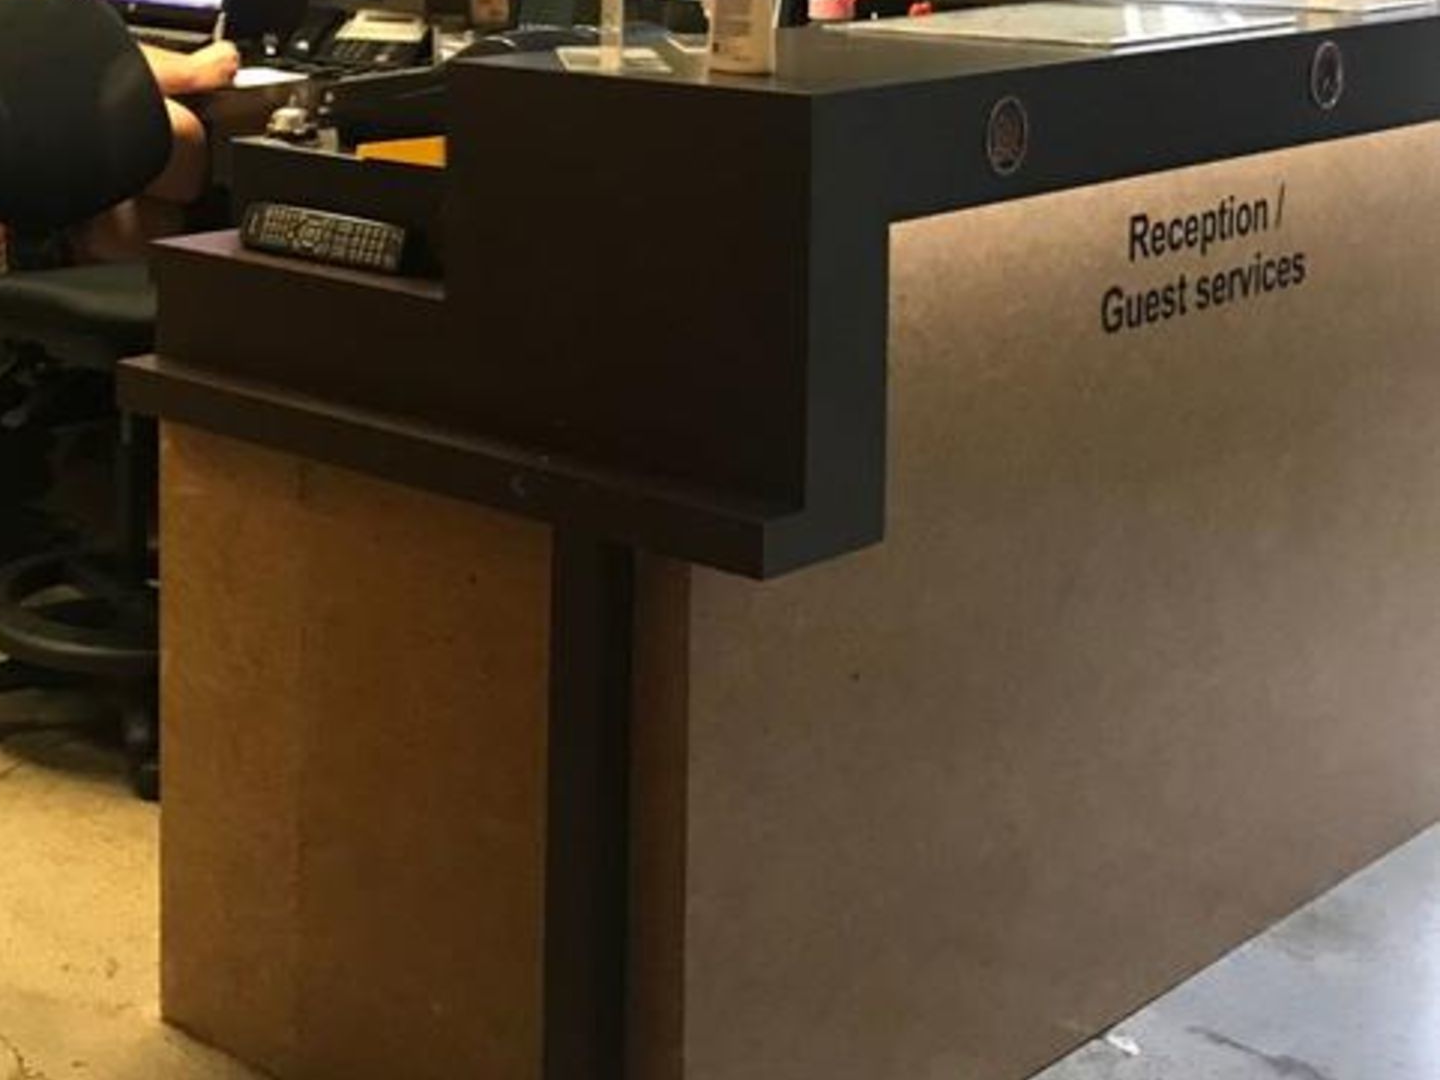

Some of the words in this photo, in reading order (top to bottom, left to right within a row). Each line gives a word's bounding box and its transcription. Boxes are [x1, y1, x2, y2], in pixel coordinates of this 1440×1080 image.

[1128, 194, 1269, 262] Reception
[1275, 180, 1286, 233] /
[1101, 273, 1188, 335] Guest
[1196, 251, 1306, 311] services
